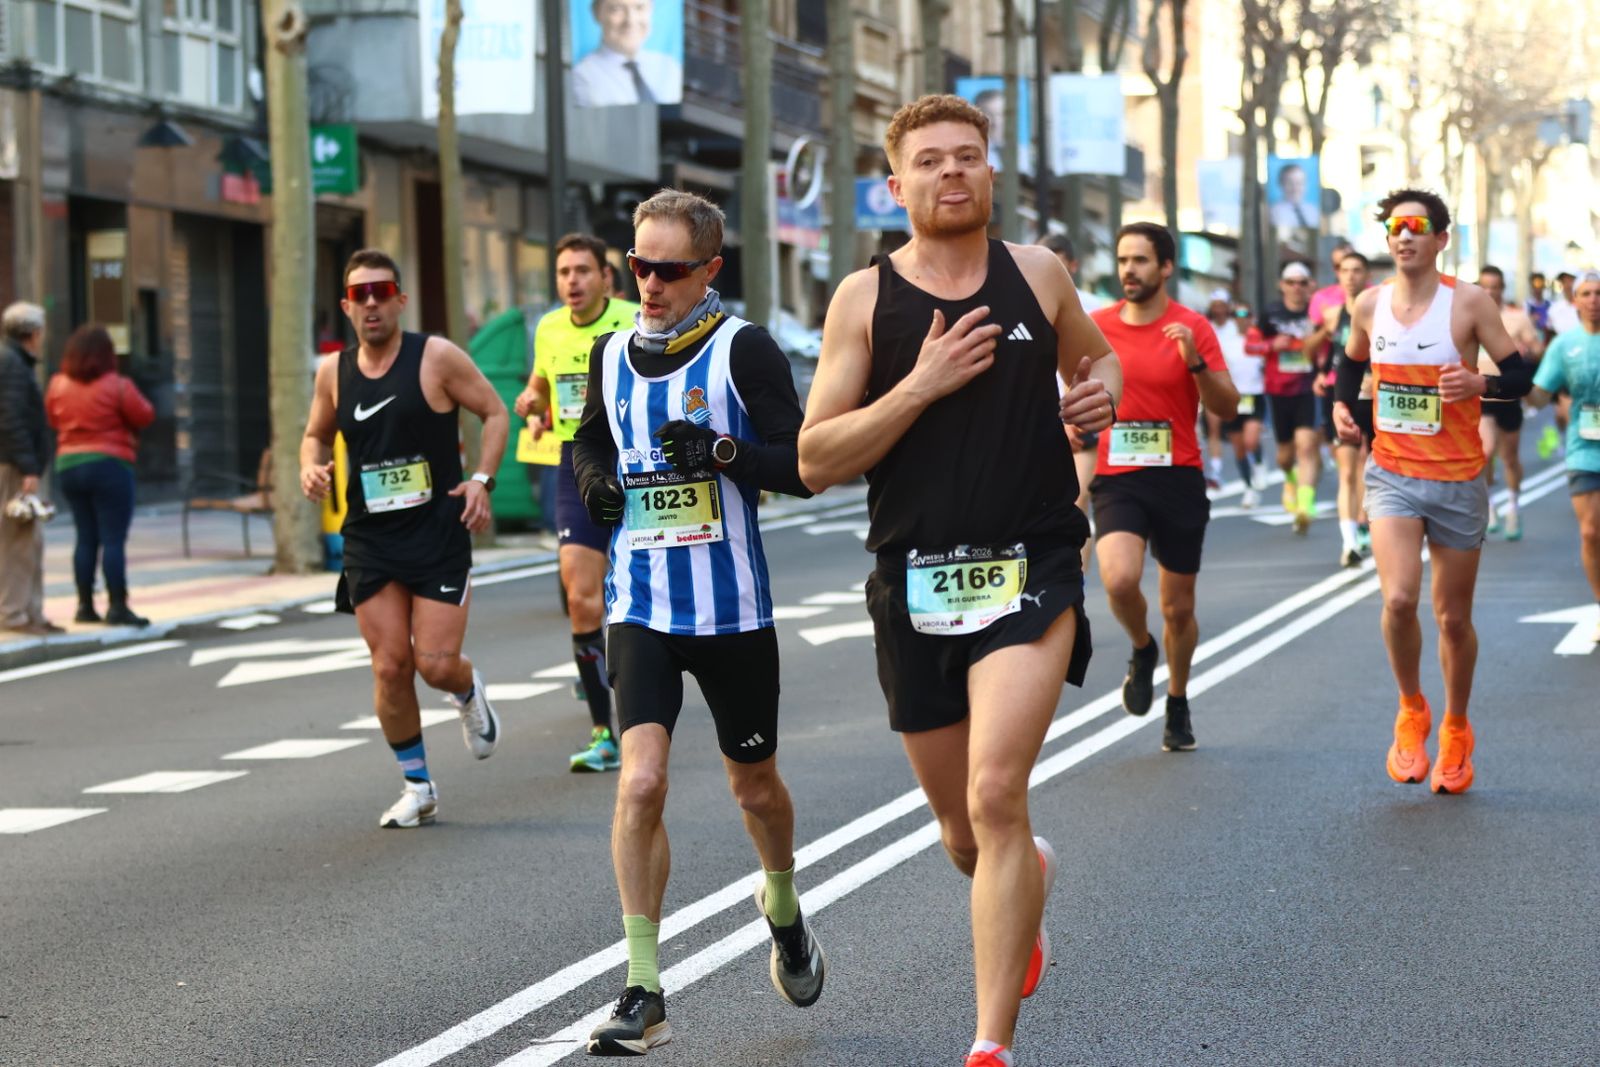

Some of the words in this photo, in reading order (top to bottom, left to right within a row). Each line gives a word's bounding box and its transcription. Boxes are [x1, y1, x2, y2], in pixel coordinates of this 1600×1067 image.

[1388, 395, 1429, 410] 1884
[1122, 431, 1160, 444] 1564
[378, 468, 412, 486] 732
[640, 487, 698, 512] 1823
[676, 532, 712, 543] bedunia
[971, 547, 993, 556] 2026
[932, 565, 1006, 593] 2166
[961, 594, 992, 604] GUERRA
